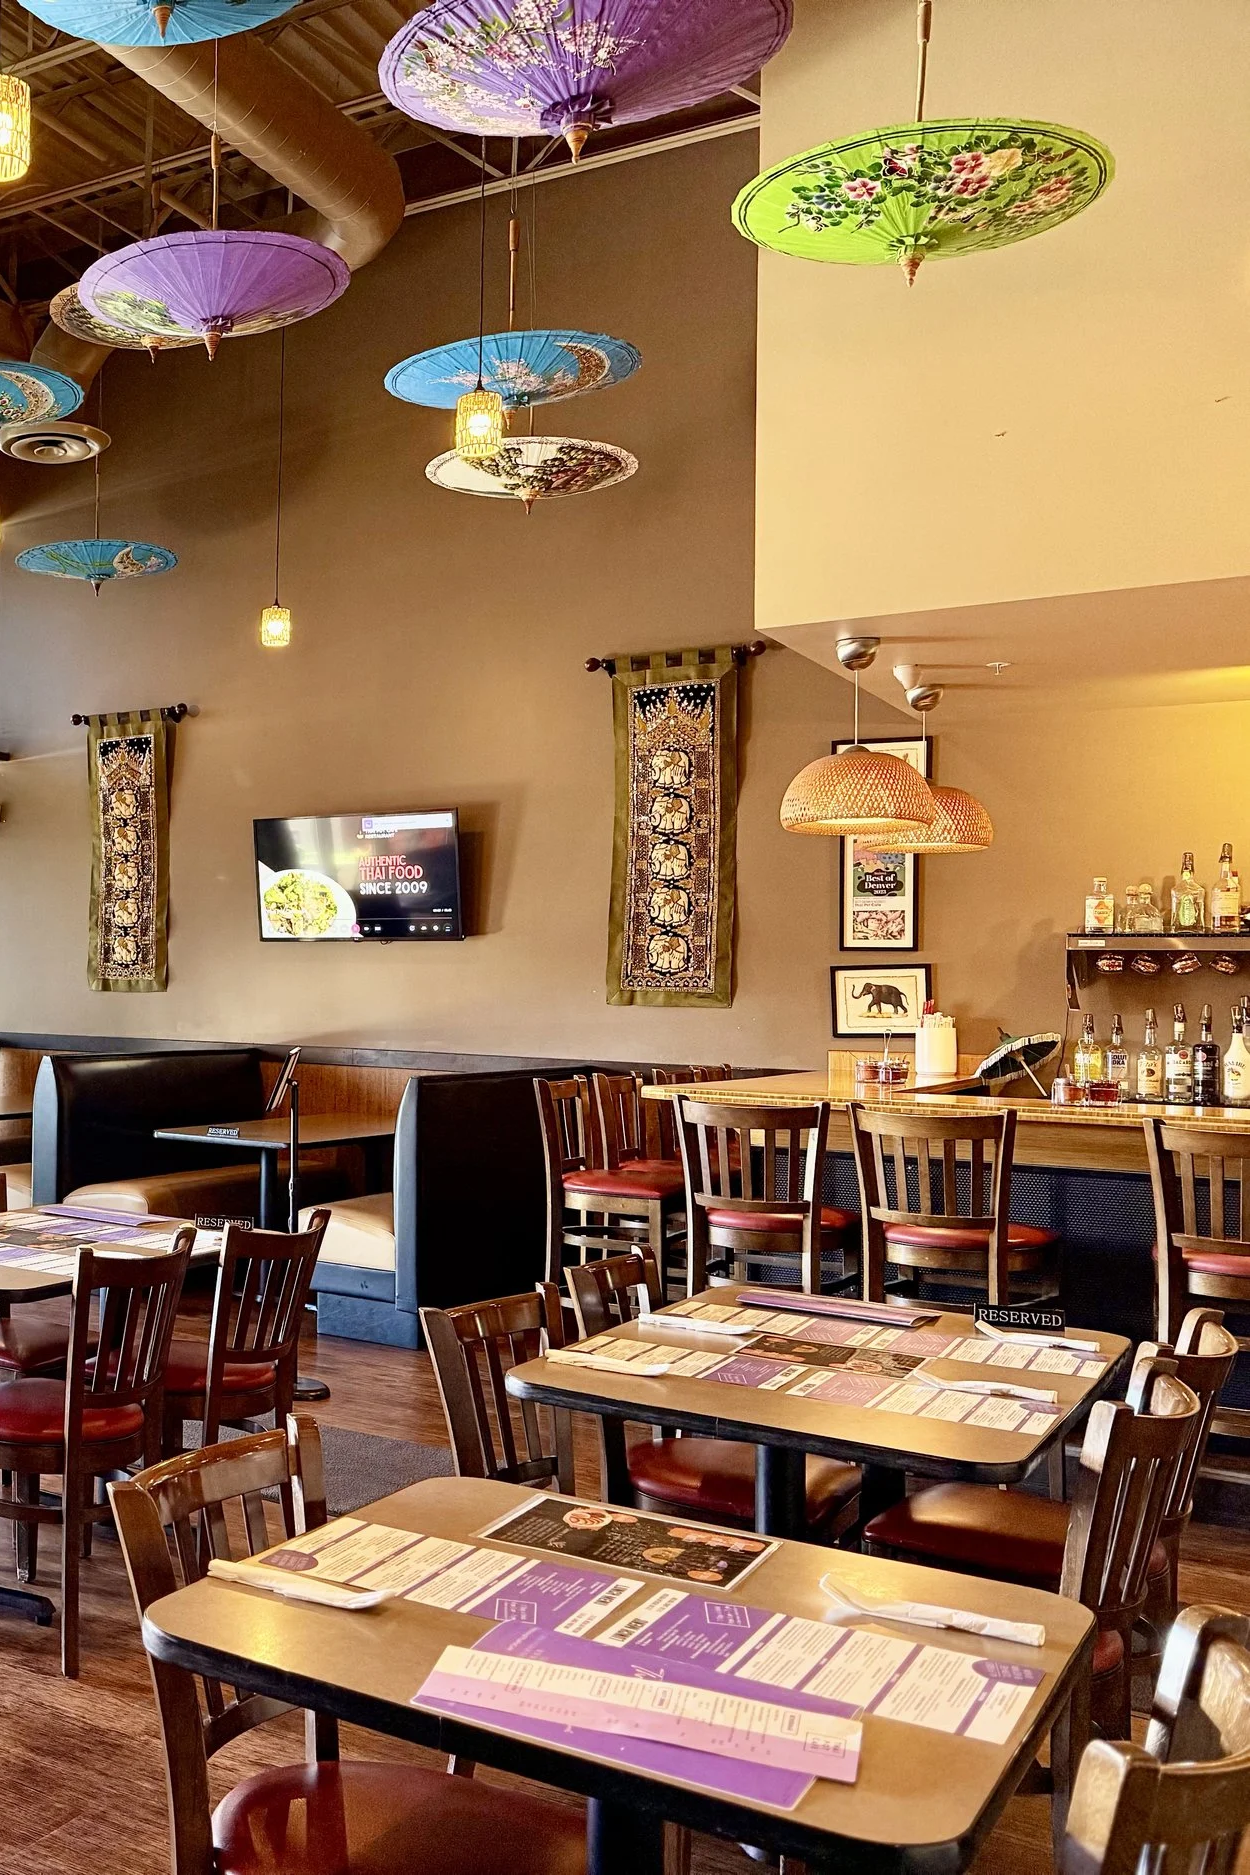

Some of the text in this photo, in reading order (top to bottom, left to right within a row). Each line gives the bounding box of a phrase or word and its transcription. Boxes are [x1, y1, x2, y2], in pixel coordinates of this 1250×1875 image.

[359, 855, 407, 867] AUTHENTIC
[359, 865, 423, 880] THAI FOOD
[359, 881, 428, 895] SINCE 2009
[209, 1127, 238, 1136] RESERVED
[978, 1308, 1062, 1327] RESERVED
